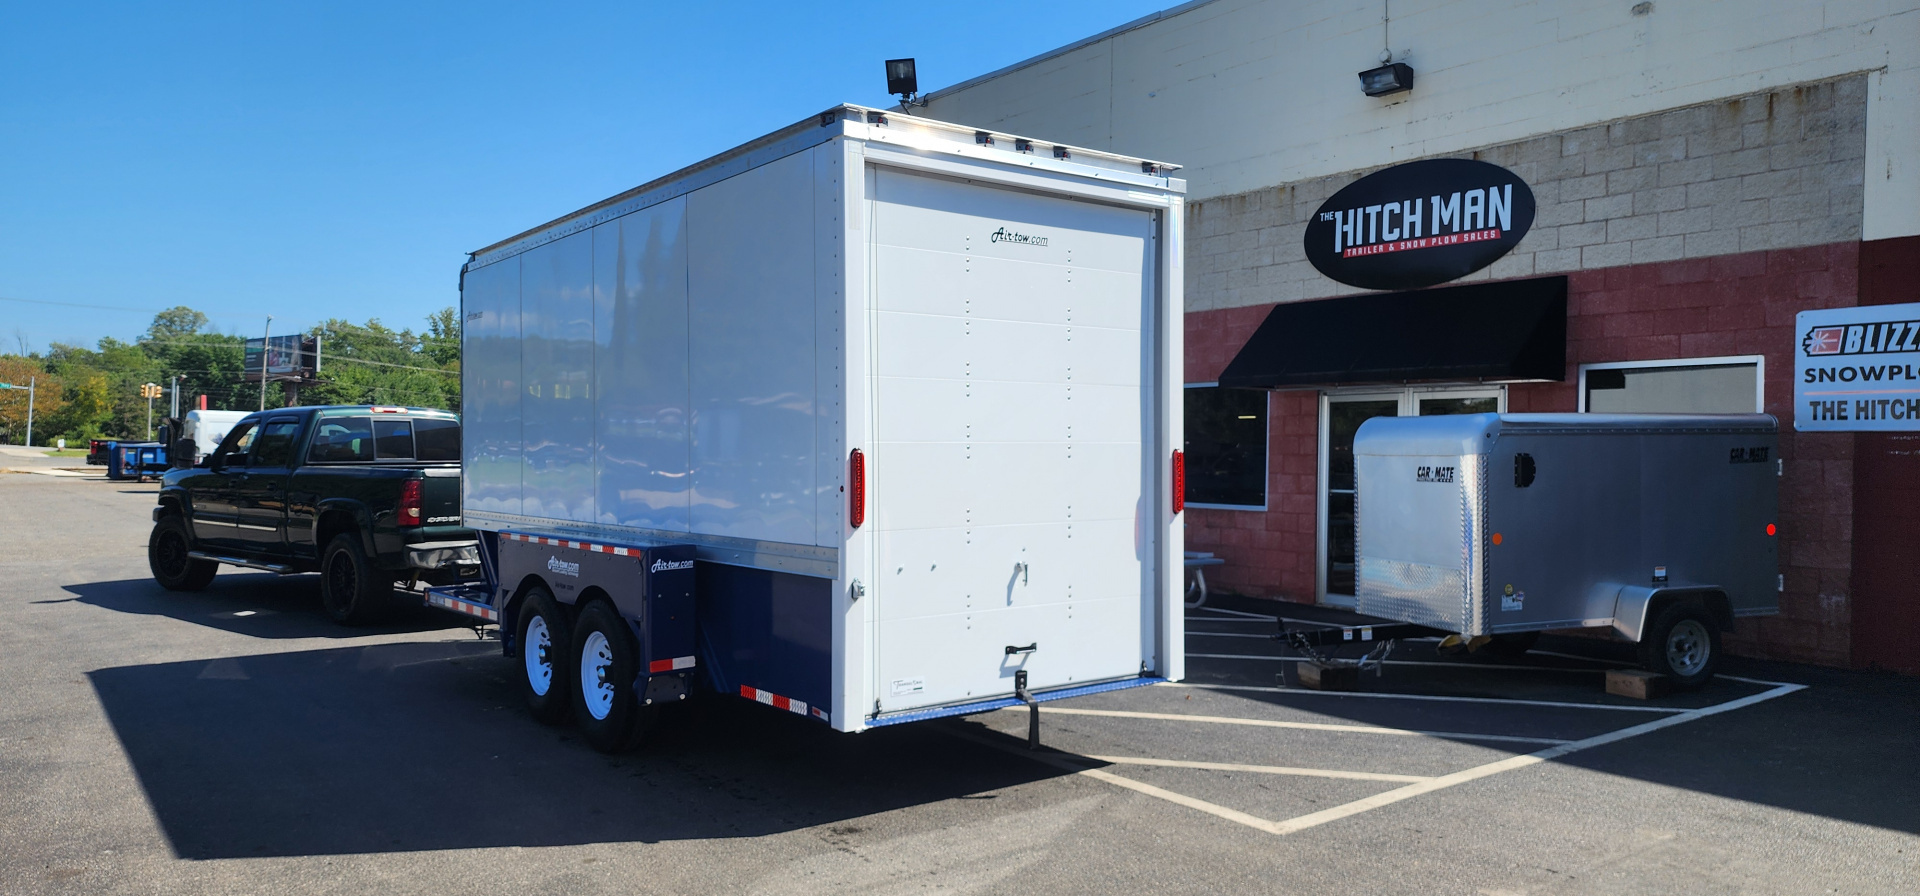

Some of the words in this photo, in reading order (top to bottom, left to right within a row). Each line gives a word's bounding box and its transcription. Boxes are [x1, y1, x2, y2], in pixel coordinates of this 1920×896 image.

[1320, 211, 1334, 222] THE
[1334, 198, 1423, 253] HITCH
[1431, 183, 1513, 235] MAN
[991, 226, 1048, 247] Air-tow.com
[1347, 245, 1384, 257] TRAILER
[1388, 242, 1395, 251] &
[1400, 238, 1427, 250] SNOW
[1431, 235, 1458, 246] PLOW
[1463, 230, 1496, 241] SALES
[1843, 321, 1920, 354] BLIZZ
[1804, 364, 1920, 383] SNOWPL
[1809, 400, 1848, 421] THE
[1855, 398, 1920, 420] HITCH
[651, 558, 694, 574] Air-tow.com
